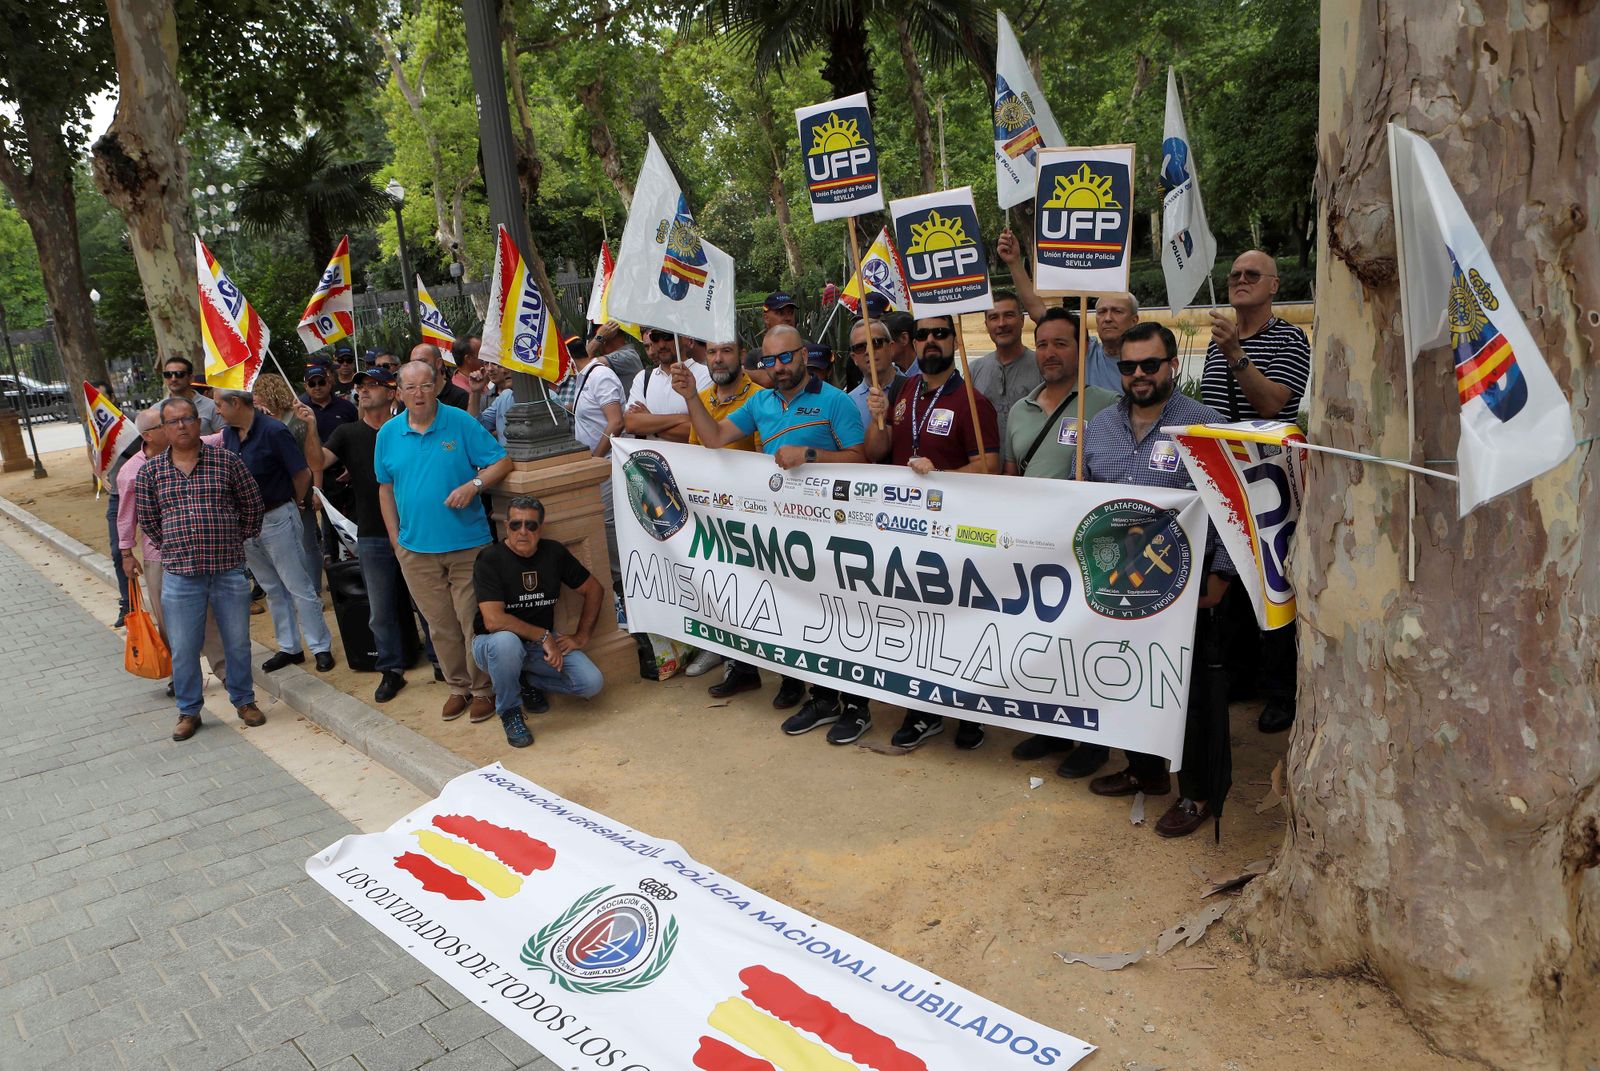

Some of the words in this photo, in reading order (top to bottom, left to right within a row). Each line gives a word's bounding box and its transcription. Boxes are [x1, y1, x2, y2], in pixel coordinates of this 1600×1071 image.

[808, 147, 871, 181] UFP
[833, 193, 855, 201] SEVILLA
[1042, 211, 1121, 240] UFP
[906, 248, 979, 281] UFP
[930, 419, 949, 427] UFP
[1152, 454, 1176, 463] UFP
[805, 476, 830, 488] CEP
[854, 482, 879, 497] SPP
[688, 494, 710, 504] AEGC
[883, 486, 922, 502] SUP
[743, 501, 768, 512] Cabos
[782, 502, 831, 519] APROGC
[927, 500, 942, 508] UFP
[1104, 502, 1156, 514] PLATAFORMA
[847, 510, 874, 522] ASES-GC
[891, 516, 928, 532] AUGC
[1075, 512, 1099, 542] SALARIAL
[1169, 520, 1183, 538] UNA
[688, 512, 816, 582] MISMO
[826, 535, 1072, 623] TRABAJO
[1090, 600, 1114, 616] PLENA
[1152, 592, 1176, 610] DIGNA
[625, 550, 782, 636] MISMA
[803, 594, 1190, 710] JUBILACIÓN
[908, 680, 1097, 728] SALARIAL
[596, 897, 640, 915] ASOCIACIÓN
[640, 903, 654, 943] GRISMAZUL
[567, 815, 660, 859] GRISMAZUL
[749, 909, 878, 983] NACIONAL
[880, 981, 1063, 1066] JUBILADOS
[336, 865, 378, 890] LOS
[364, 886, 463, 957] OLVIDADOS
[455, 951, 500, 978] DE
[487, 971, 576, 1032] TODOS
[561, 1025, 627, 1068] LOS
[580, 966, 627, 976] JUBILADOS
